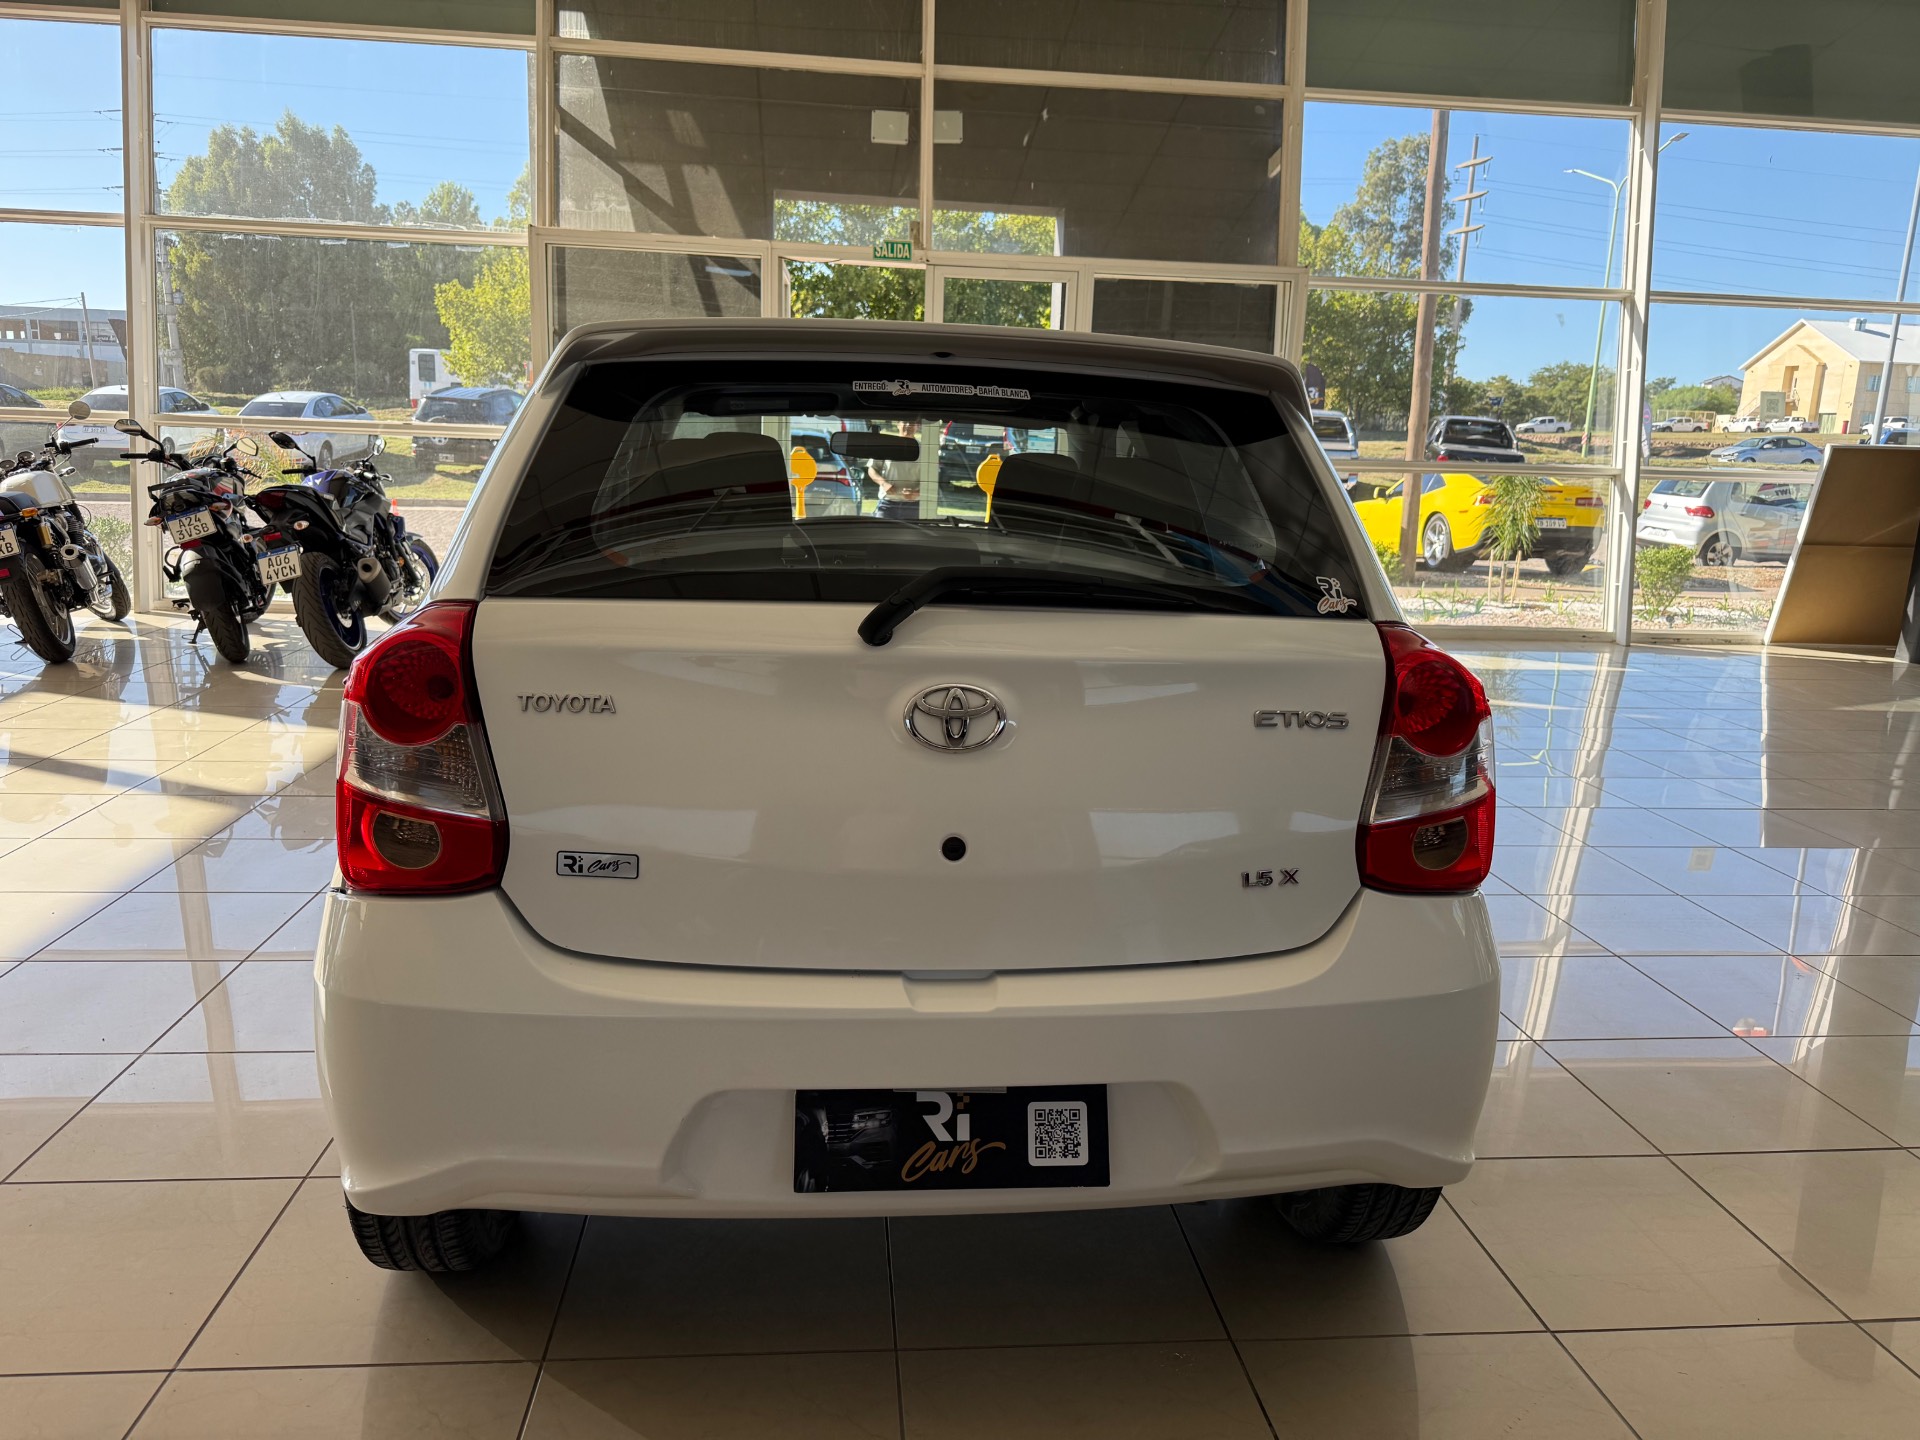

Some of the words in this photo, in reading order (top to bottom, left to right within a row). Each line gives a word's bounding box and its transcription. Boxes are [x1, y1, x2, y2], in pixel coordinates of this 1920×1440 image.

[875, 243, 910, 259] SALIDA
[921, 384, 973, 394] AUTOMOTORES
[978, 386, 1000, 396] BAHÍA
[1001, 389, 1029, 399] BLANCA
[178, 514, 202, 529] A24
[176, 522, 210, 540] 3VSB
[267, 553, 290, 569] A06
[266, 564, 297, 581] 4YCN
[1317, 597, 1357, 614] Cars
[517, 693, 616, 714] TOYOTA
[1253, 710, 1350, 729] ETIOS
[587, 859, 631, 873] Cars
[1241, 869, 1273, 888] 1.5
[1278, 868, 1299, 886] X
[901, 1138, 1006, 1182] Cars
